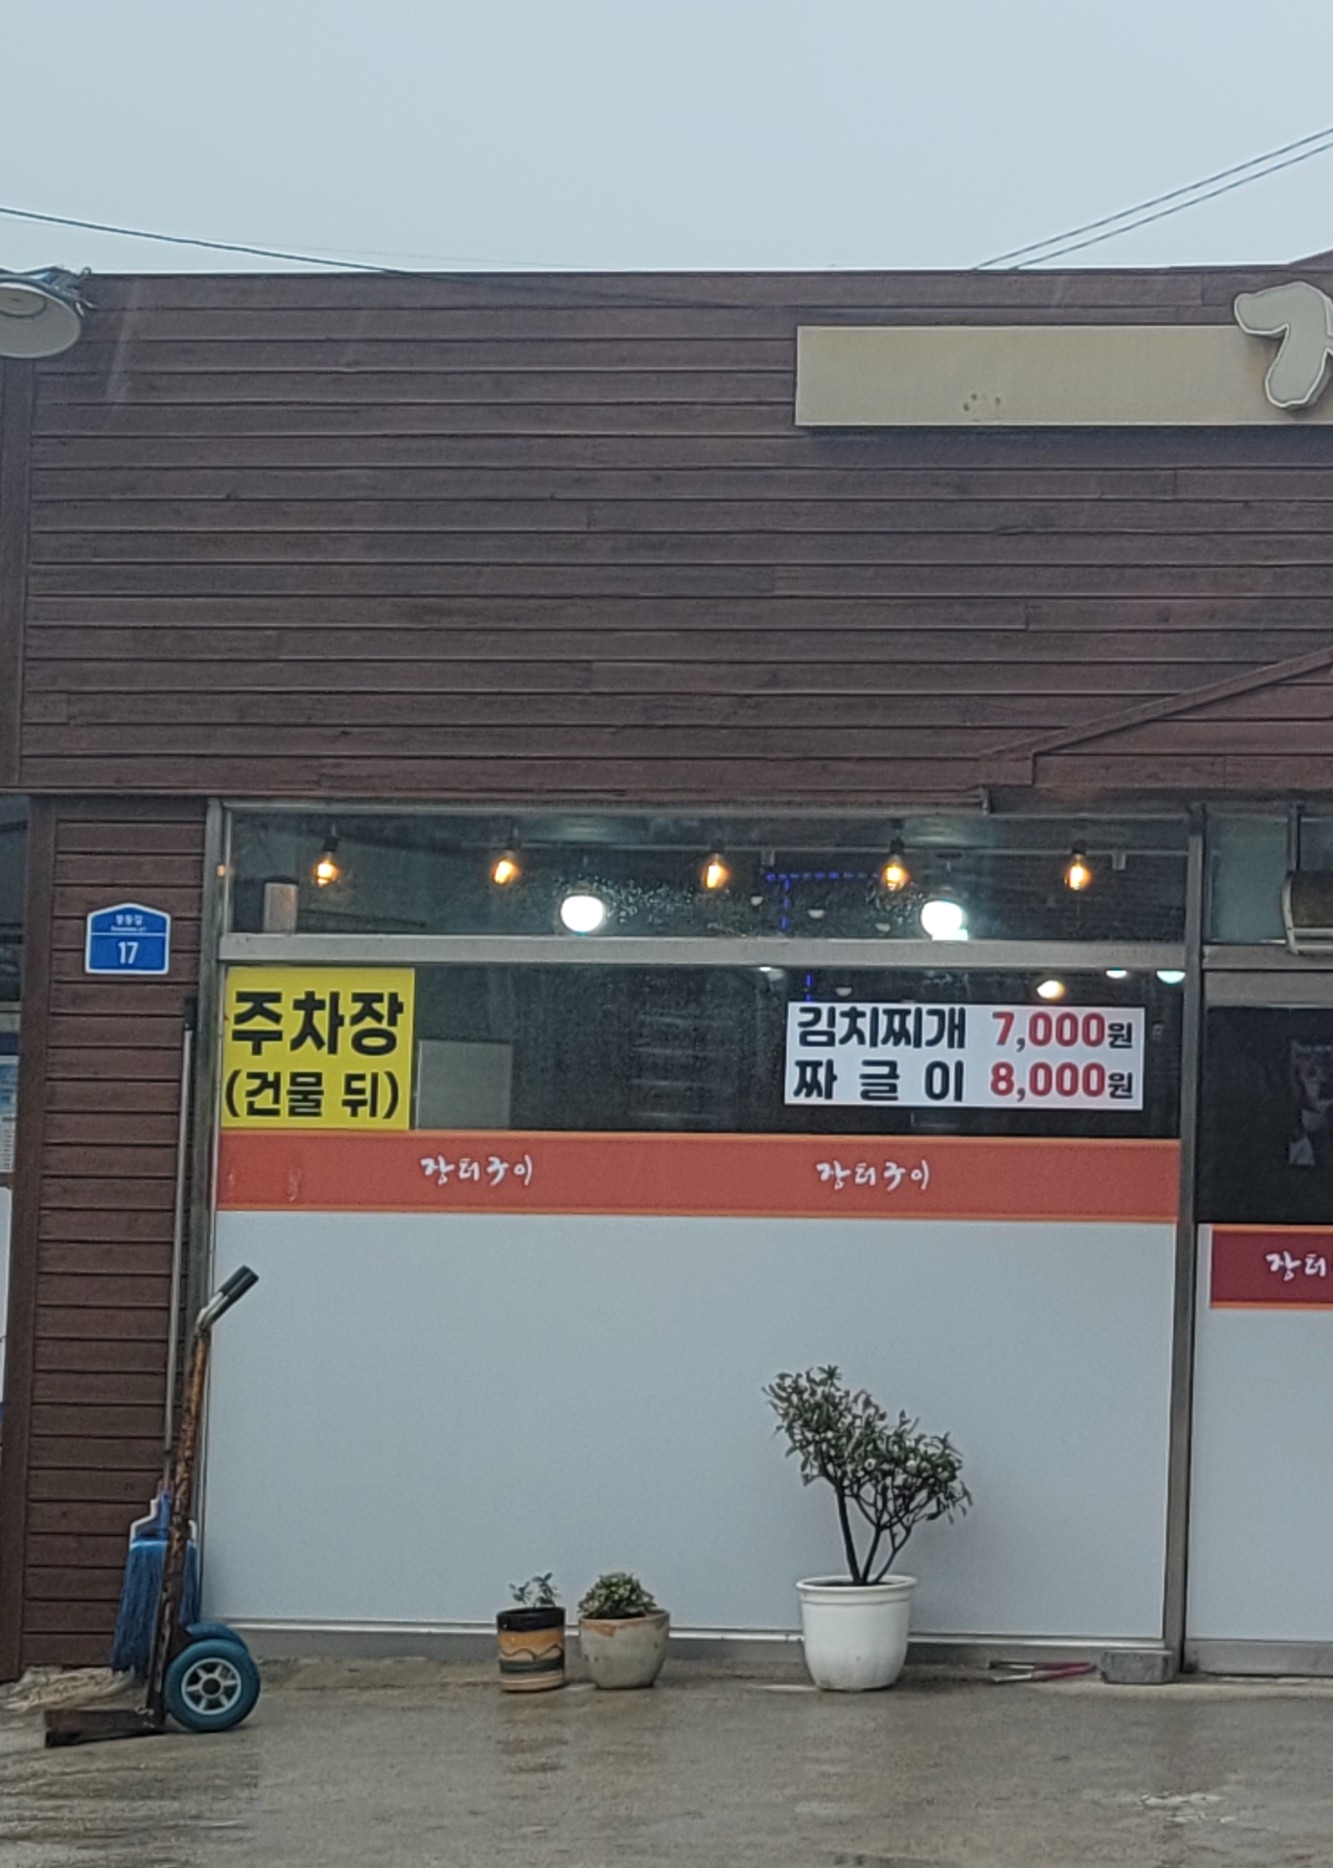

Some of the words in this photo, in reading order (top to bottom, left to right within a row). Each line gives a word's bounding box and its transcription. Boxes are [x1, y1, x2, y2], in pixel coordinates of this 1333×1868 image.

[119, 942, 138, 964] 17
[232, 991, 403, 1056] 주차장
[797, 1006, 967, 1049] 김치찌개
[993, 1012, 1133, 1052] 7,000원
[226, 1069, 324, 1117] (건물
[342, 1071, 398, 1119] 뒤)
[991, 1063, 1133, 1101] 8,000원
[421, 1155, 532, 1185] 장터구이
[817, 1160, 929, 1190] 장터구이
